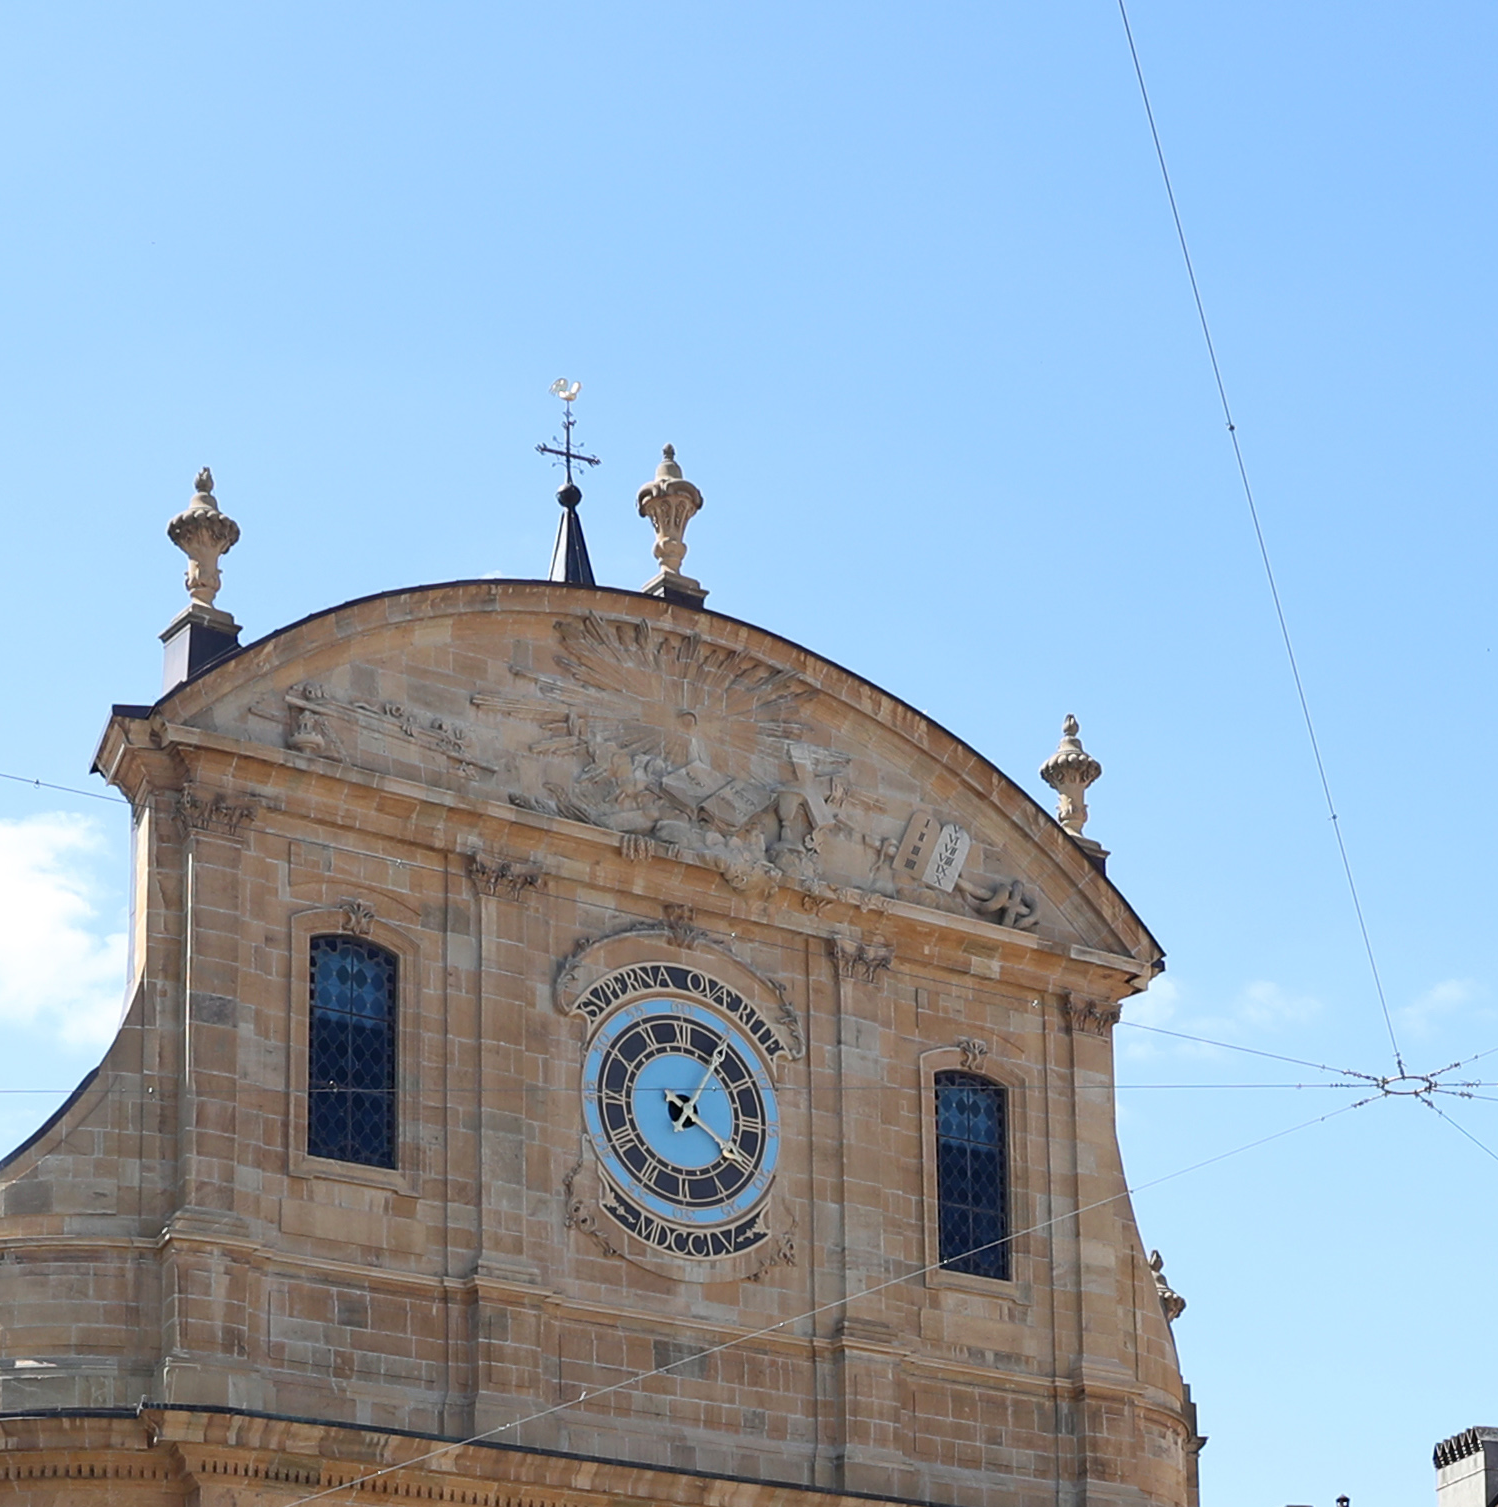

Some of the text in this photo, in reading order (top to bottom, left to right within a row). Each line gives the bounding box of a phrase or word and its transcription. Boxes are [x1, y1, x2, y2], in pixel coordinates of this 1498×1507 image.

[580, 966, 674, 1020] SVPERNA
[673, 1022, 691, 1047] XII
[741, 1117, 760, 1133] III
[634, 1213, 735, 1257] MDCCLV
